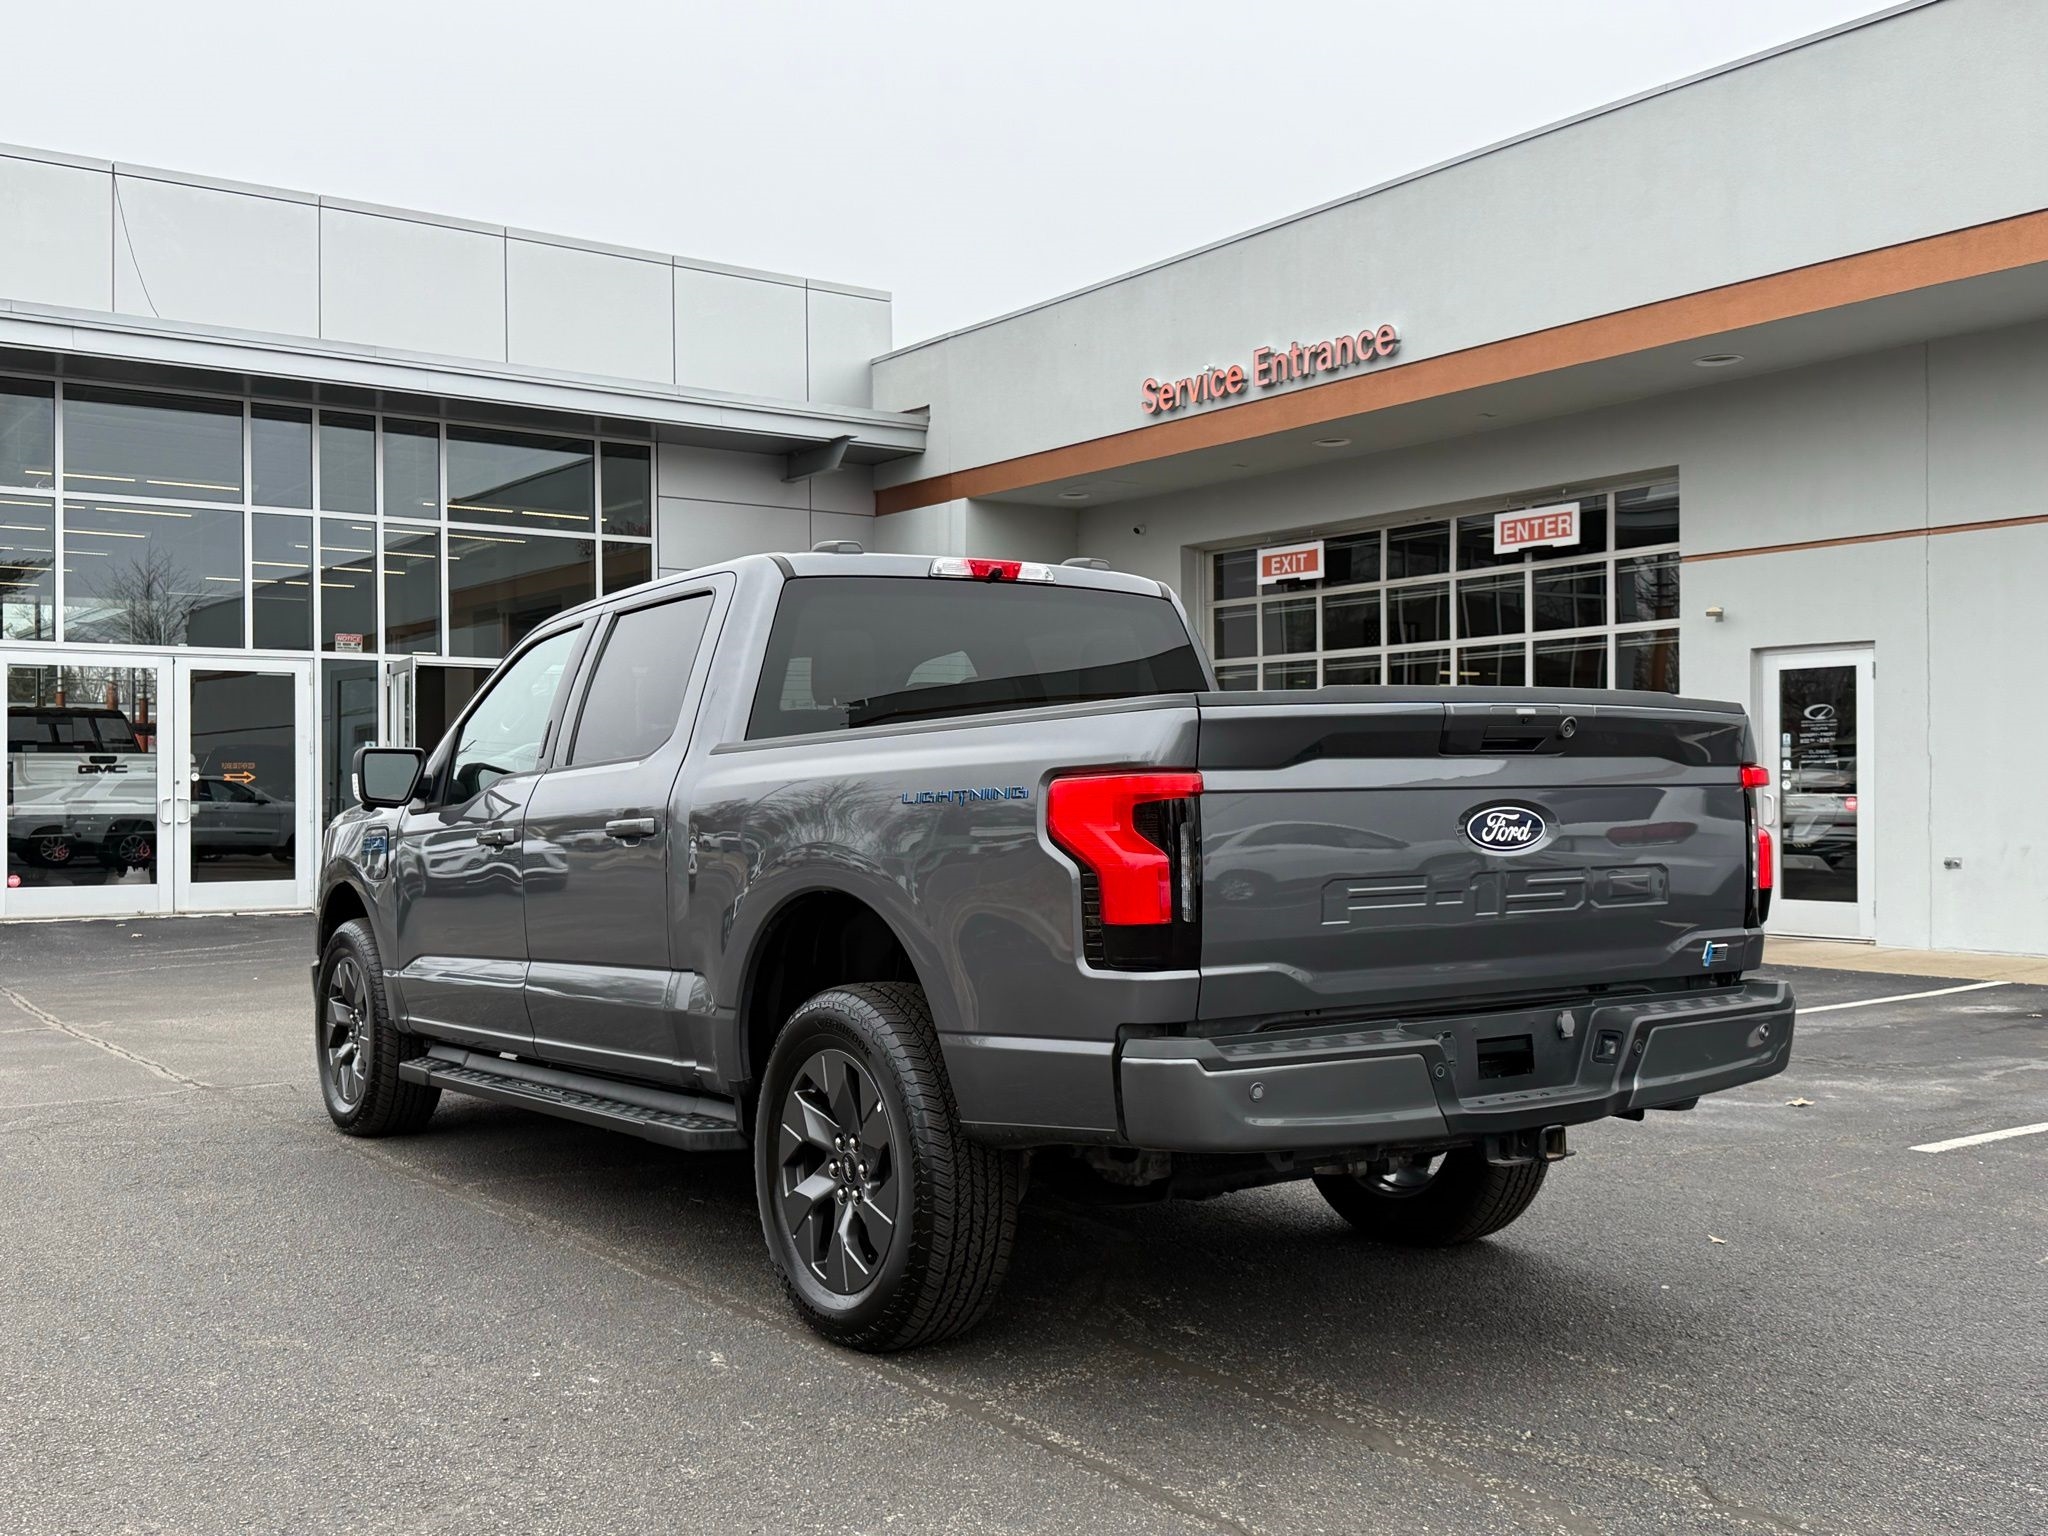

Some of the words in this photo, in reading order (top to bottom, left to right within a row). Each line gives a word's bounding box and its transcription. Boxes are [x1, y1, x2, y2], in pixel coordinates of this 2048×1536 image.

[1141, 364, 1245, 415] Service
[1253, 324, 1398, 388] Entrance
[1502, 514, 1572, 544] ENTER
[1270, 552, 1308, 575] EXIT
[337, 634, 361, 643] NOTICE
[78, 765, 128, 774] GMC
[901, 786, 1029, 807] LIGHTNING
[1481, 812, 1532, 842] Ford
[1321, 863, 1669, 926] F-150
